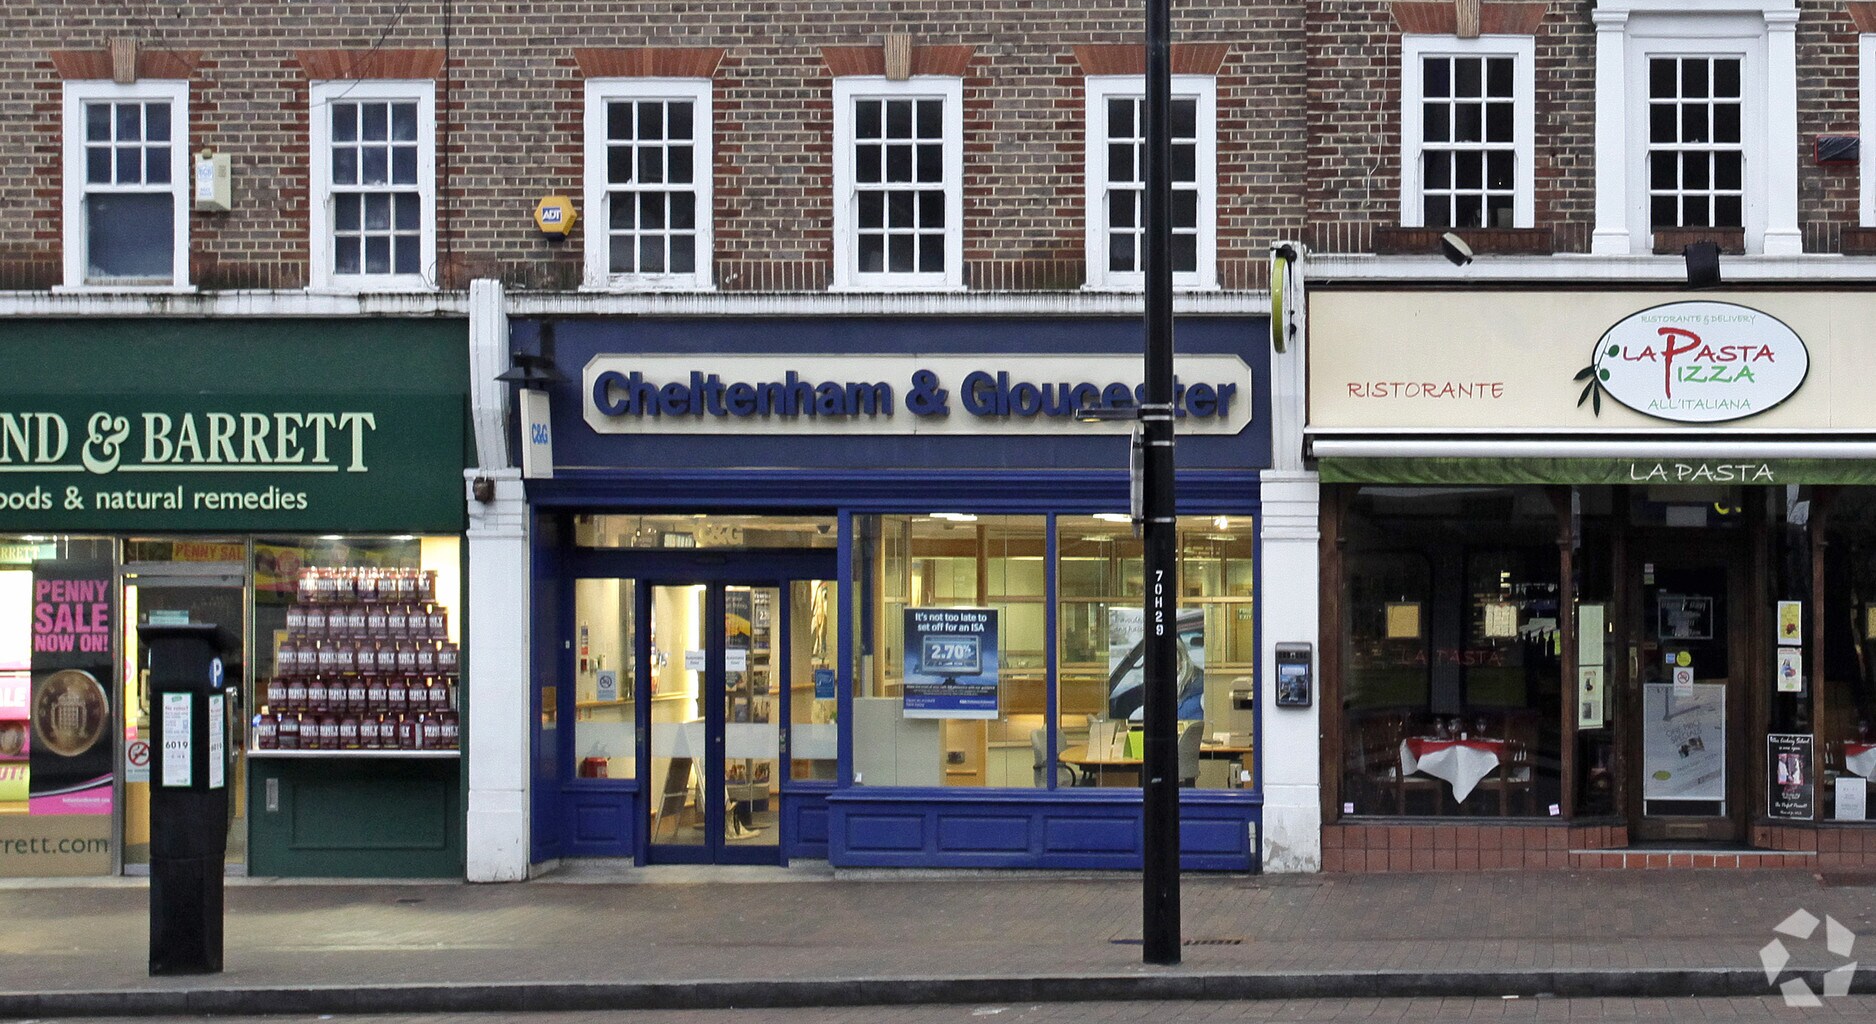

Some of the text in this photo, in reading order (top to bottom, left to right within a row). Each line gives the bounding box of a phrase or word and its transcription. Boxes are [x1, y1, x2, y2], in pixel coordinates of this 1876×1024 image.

[543, 210, 562, 221] ADT
[1641, 315, 1701, 323] RISTORANTE
[1711, 315, 1756, 325] DELIVERY
[1623, 327, 1775, 399] LA PASTA
[593, 370, 892, 417] Cheltenham
[904, 370, 950, 416] &
[1347, 381, 1504, 399] RISTORANTE
[1648, 398, 1751, 410] ALL'ITALIANA
[82, 410, 130, 474] &
[141, 412, 377, 473] BARRETT
[531, 423, 549, 444] C&G
[1631, 462, 1774, 482] LA PASTA
[64, 485, 85, 510] &
[96, 485, 183, 510] natural
[193, 485, 308, 510] remedies
[175, 543, 218, 559] PENNY
[35, 580, 108, 602] PENNY
[35, 603, 108, 633] SALE
[915, 612, 987, 622] It's not too late to
[917, 622, 985, 632] set off for an ISA
[35, 634, 108, 652] NOW ON!
[165, 741, 189, 749] 6019
[0, 837, 108, 854] rett.com
